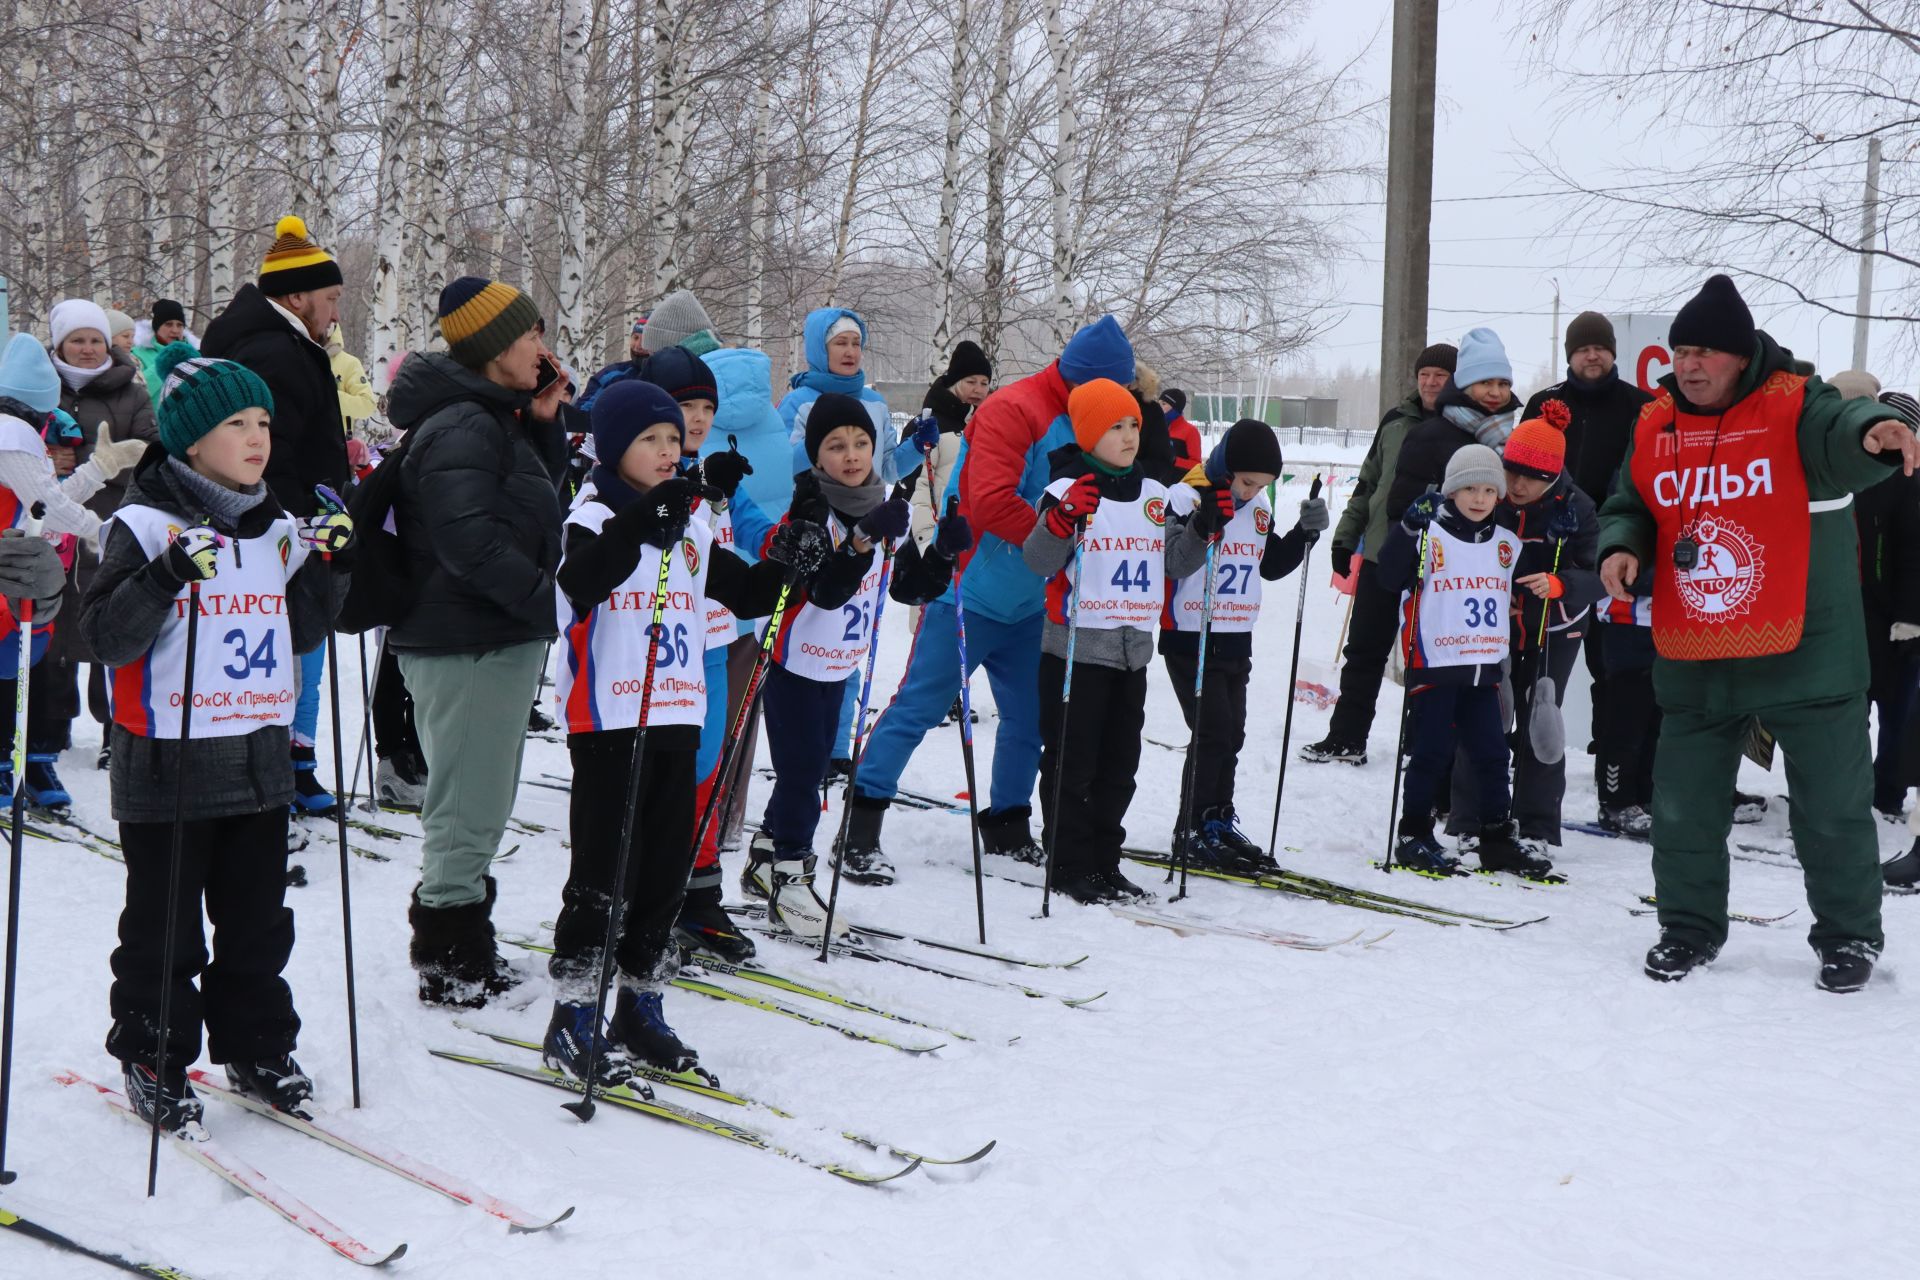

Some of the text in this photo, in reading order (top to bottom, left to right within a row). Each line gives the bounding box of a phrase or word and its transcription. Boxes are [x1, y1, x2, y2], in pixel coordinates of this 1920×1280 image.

[1653, 458, 1773, 509] СУДЬЯ
[1111, 559, 1151, 593] 44
[1217, 563, 1253, 595] 27
[1700, 579, 1726, 591] ГТО
[174, 594, 289, 619] ТАТАРСТ
[1464, 597, 1498, 628] 38
[223, 628, 277, 680] 34
[644, 623, 688, 668] 36
[777, 903, 823, 923] FISCHER
[561, 1027, 581, 1056] NORDWAY
